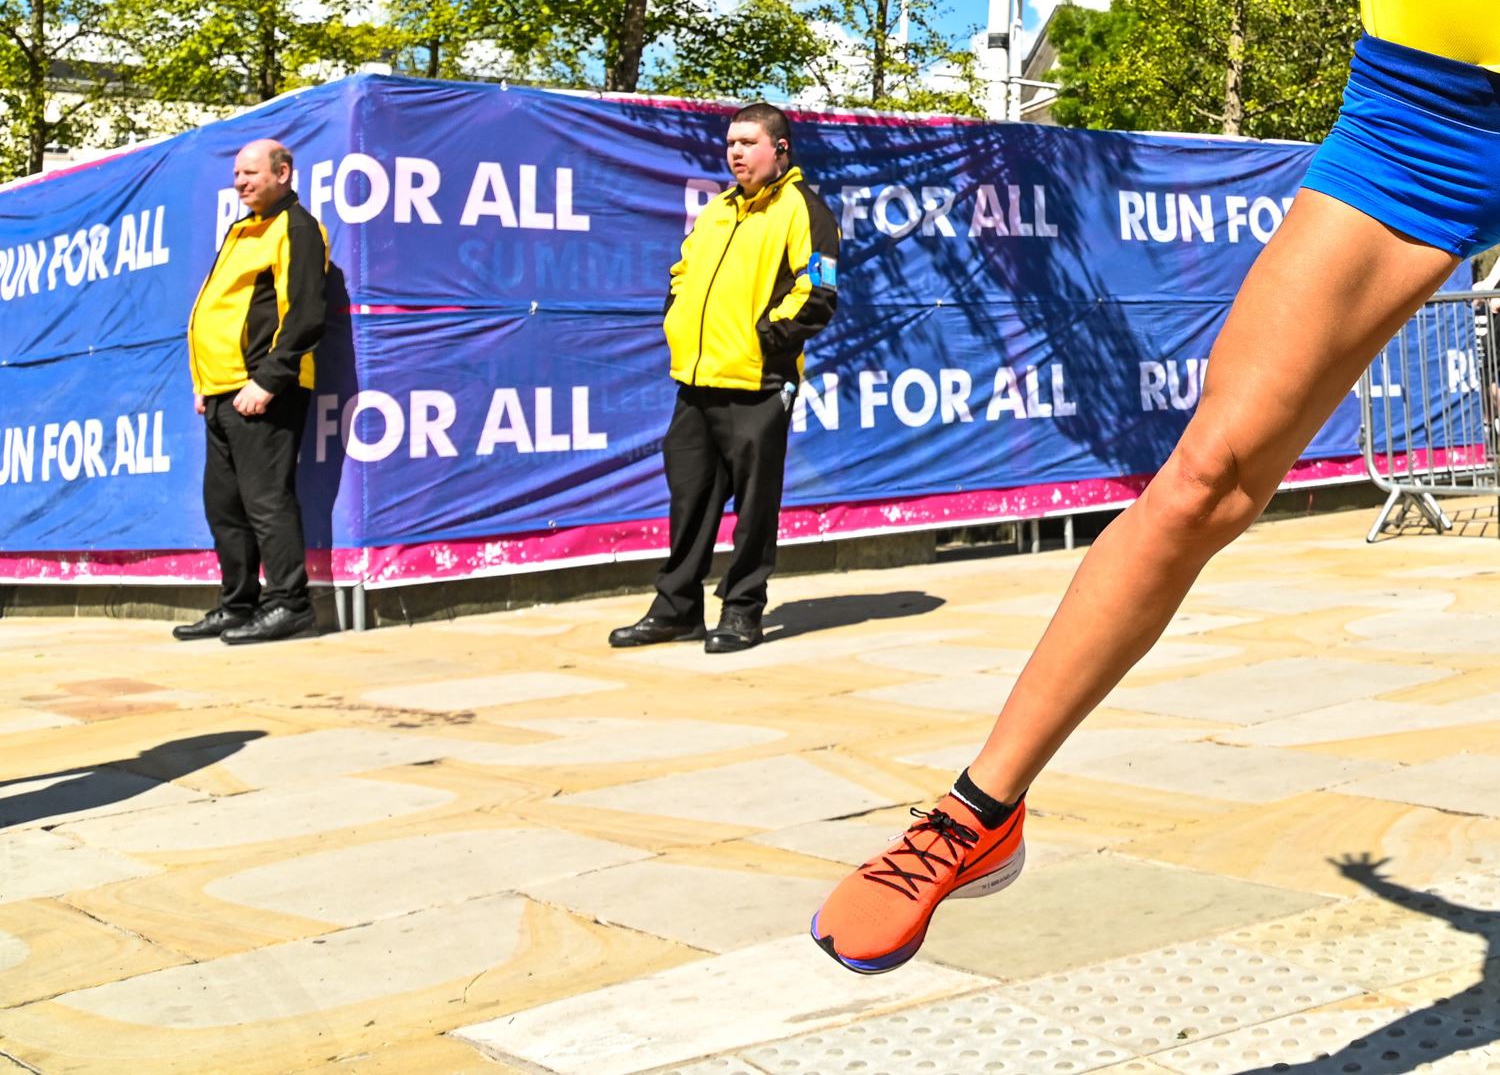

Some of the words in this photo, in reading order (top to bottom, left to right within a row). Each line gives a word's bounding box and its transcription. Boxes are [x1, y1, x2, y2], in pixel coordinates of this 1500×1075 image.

[310, 153, 442, 225] FOR
[459, 161, 590, 231] ALL
[841, 184, 957, 240] FOR
[968, 183, 1058, 238] ALL
[1118, 190, 1215, 243] RUN
[47, 223, 110, 291] FOR
[113, 205, 170, 276] ALL
[858, 368, 974, 429] FOR
[985, 363, 1077, 421] ALL
[1138, 358, 1209, 412] RU
[0, 425, 36, 486] UN
[41, 418, 107, 482] FOR
[111, 410, 170, 476] ALL
[315, 389, 459, 463] FOR
[475, 385, 608, 456] ALL
